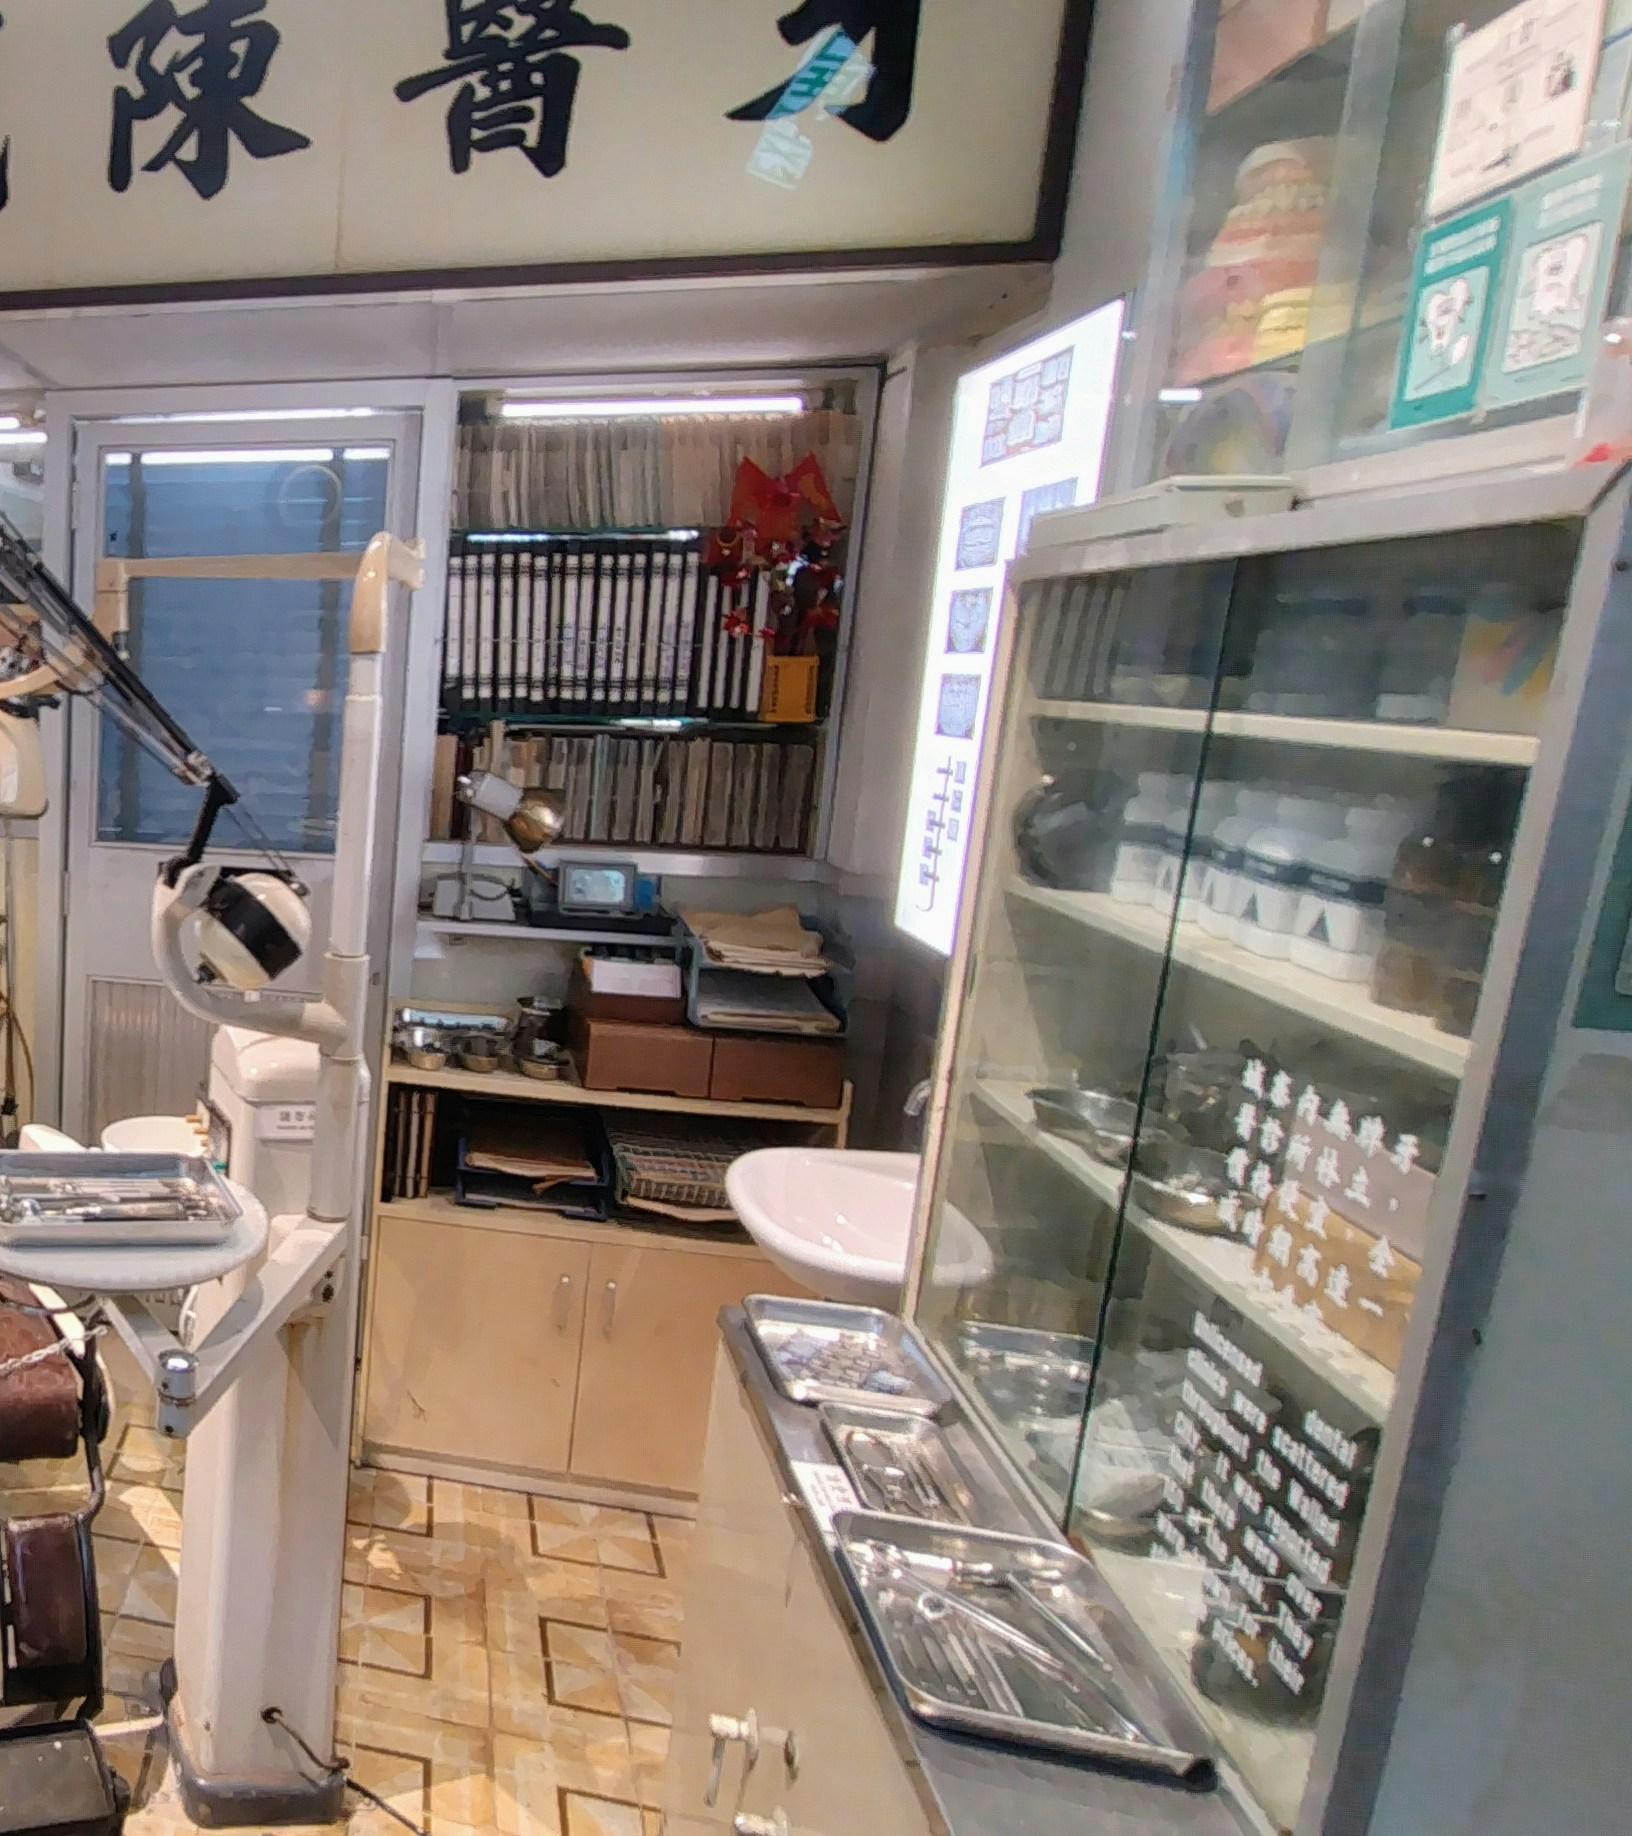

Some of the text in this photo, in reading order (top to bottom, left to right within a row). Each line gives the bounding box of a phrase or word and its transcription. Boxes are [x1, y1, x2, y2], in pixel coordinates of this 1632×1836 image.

[1256, 1448, 1282, 1491] the
[1288, 1478, 1342, 1547] Walled
[1271, 1425, 1350, 1510] scattered
